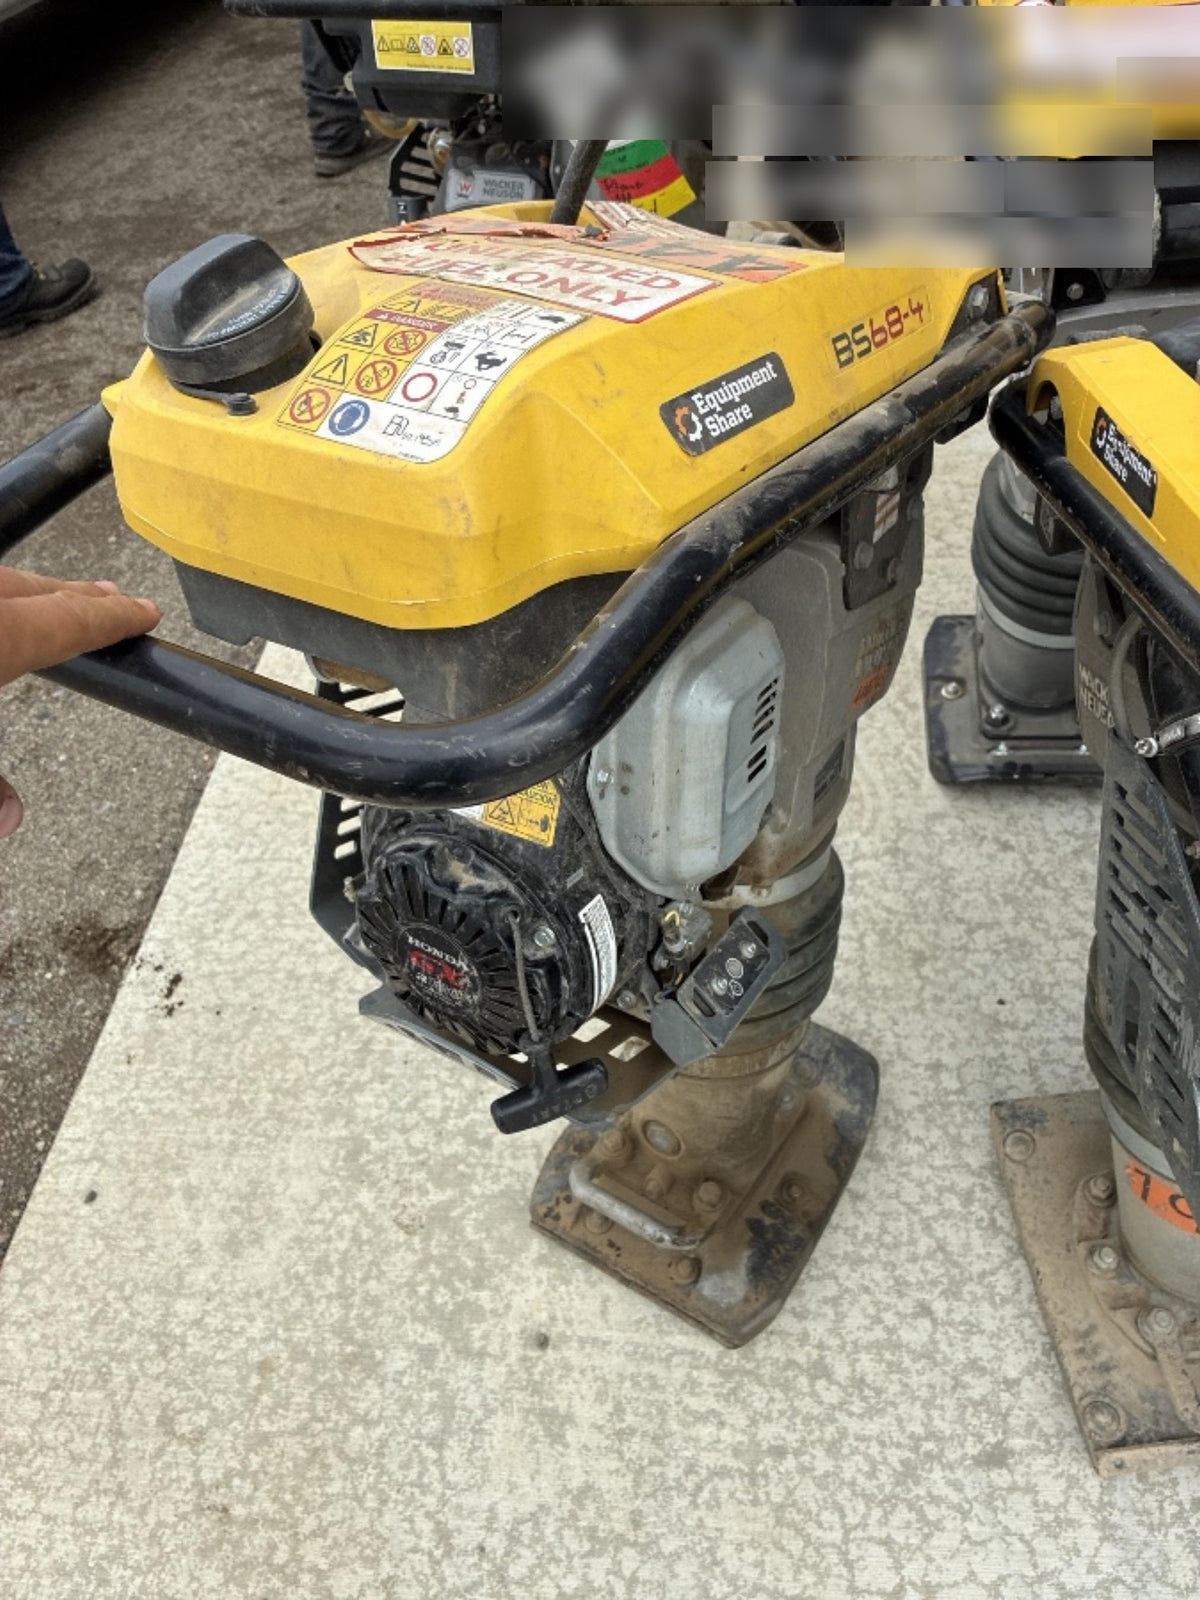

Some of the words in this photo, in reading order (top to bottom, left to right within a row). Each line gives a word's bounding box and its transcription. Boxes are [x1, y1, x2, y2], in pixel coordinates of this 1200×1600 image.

[483, 187, 523, 200] NEUSON
[484, 179, 524, 192] WACKER
[380, 253, 490, 278] FUEL
[506, 271, 651, 306] ONLY
[424, 241, 681, 290] UNLEADED
[832, 298, 924, 369] BS68-4
[691, 361, 778, 415] Equipment
[704, 403, 753, 438] Share
[1104, 442, 1128, 483] Share
[1107, 423, 1153, 488] Equipment
[405, 932, 470, 972] HONDA
